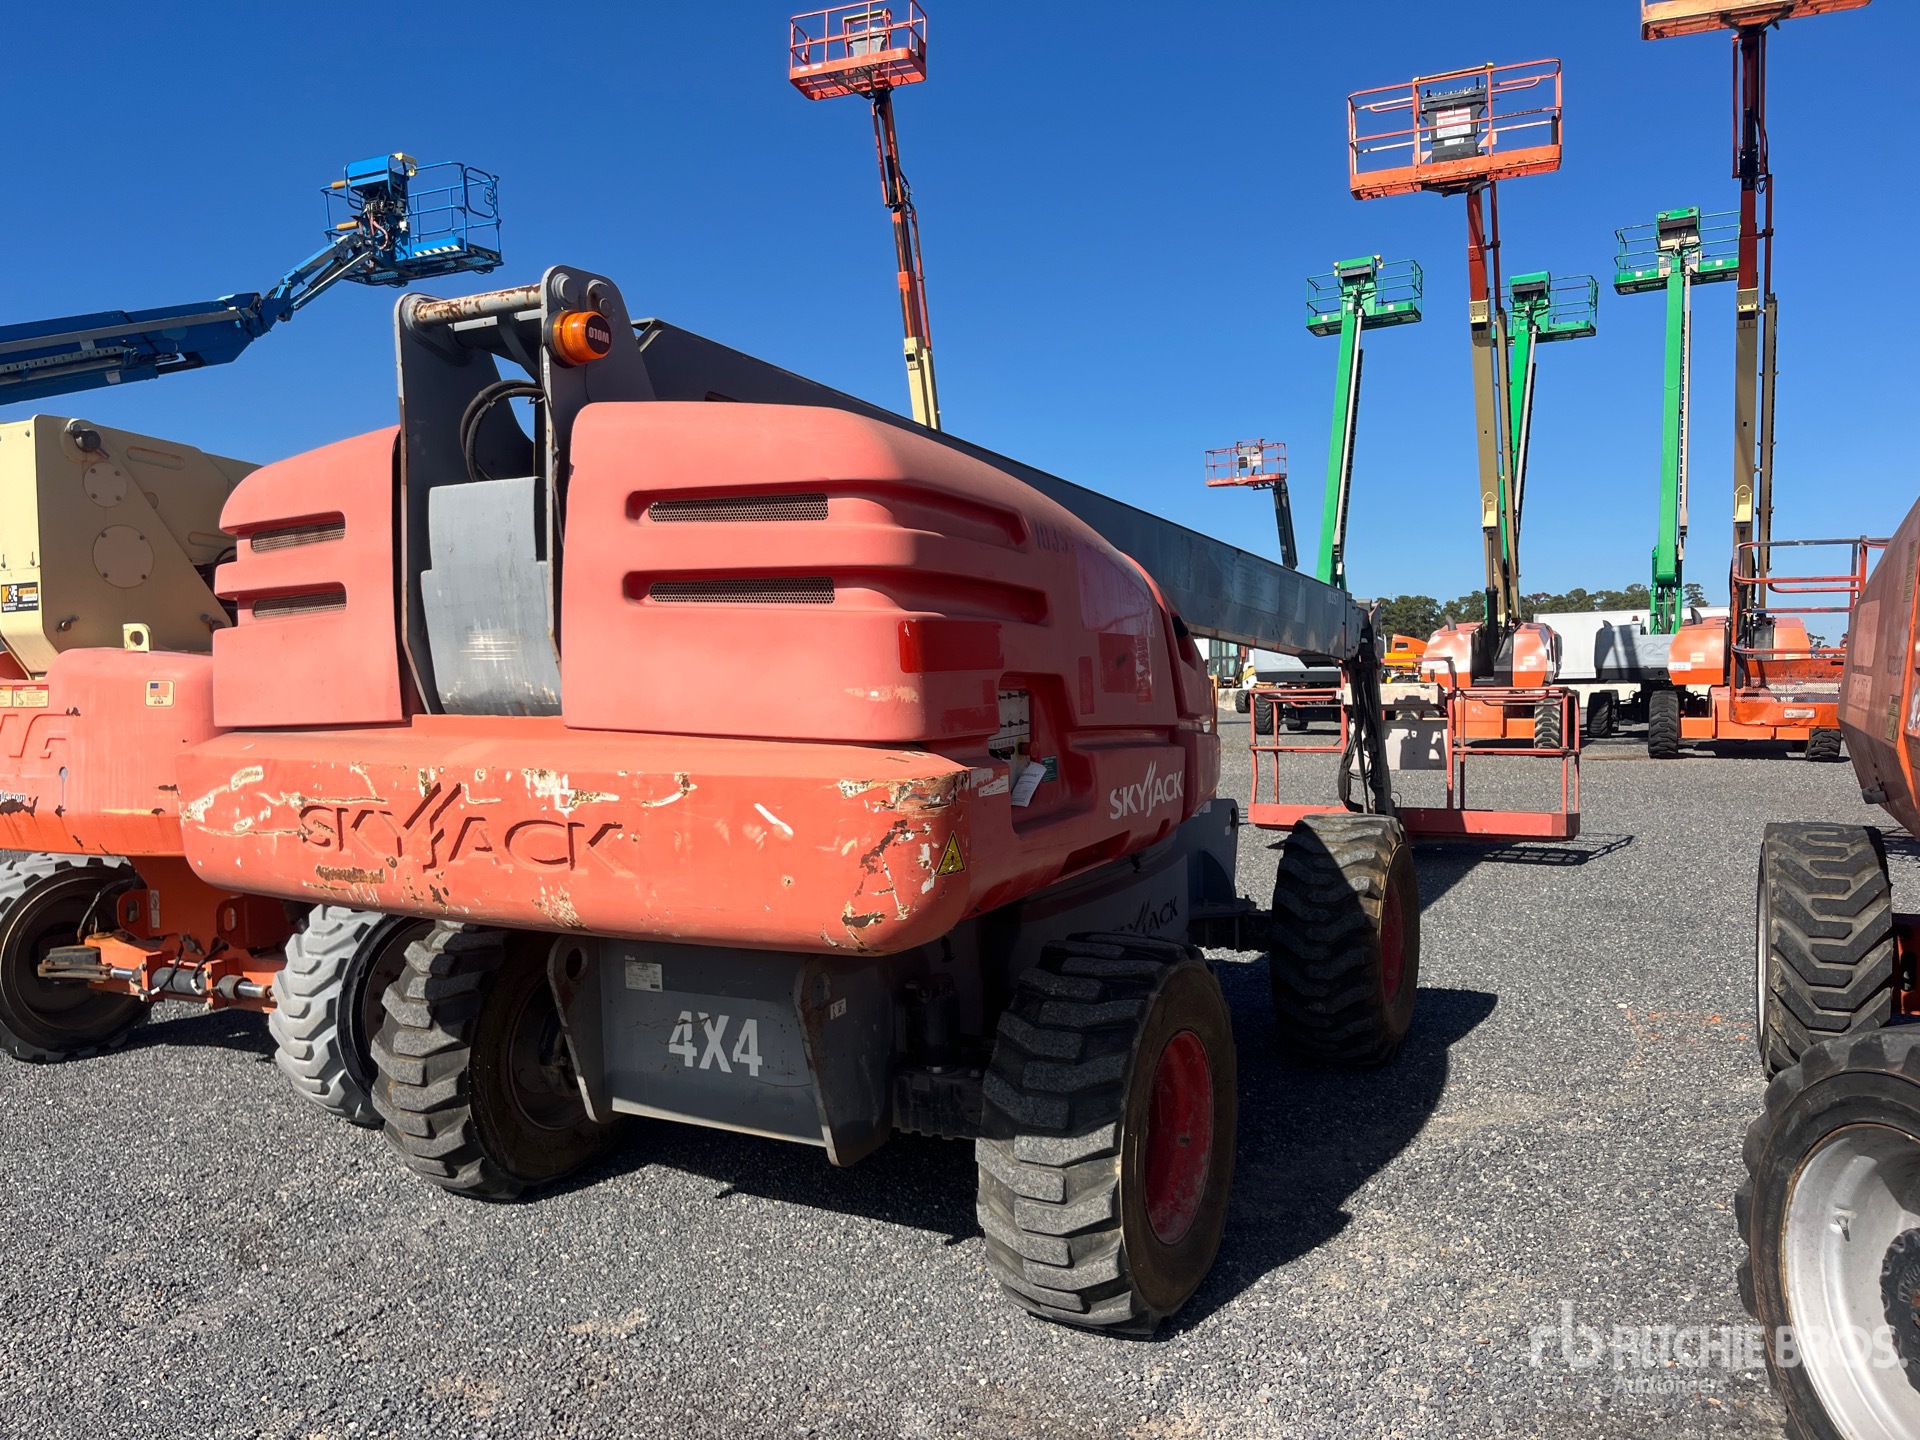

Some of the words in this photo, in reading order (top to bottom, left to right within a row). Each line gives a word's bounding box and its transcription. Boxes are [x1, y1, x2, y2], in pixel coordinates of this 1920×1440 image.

[588, 326, 610, 344] WOLO
[1109, 760, 1184, 820] SKYJACK
[299, 782, 636, 878] SKYJACK
[1112, 895, 1178, 934] YJACK
[668, 1010, 763, 1077] 4X4
